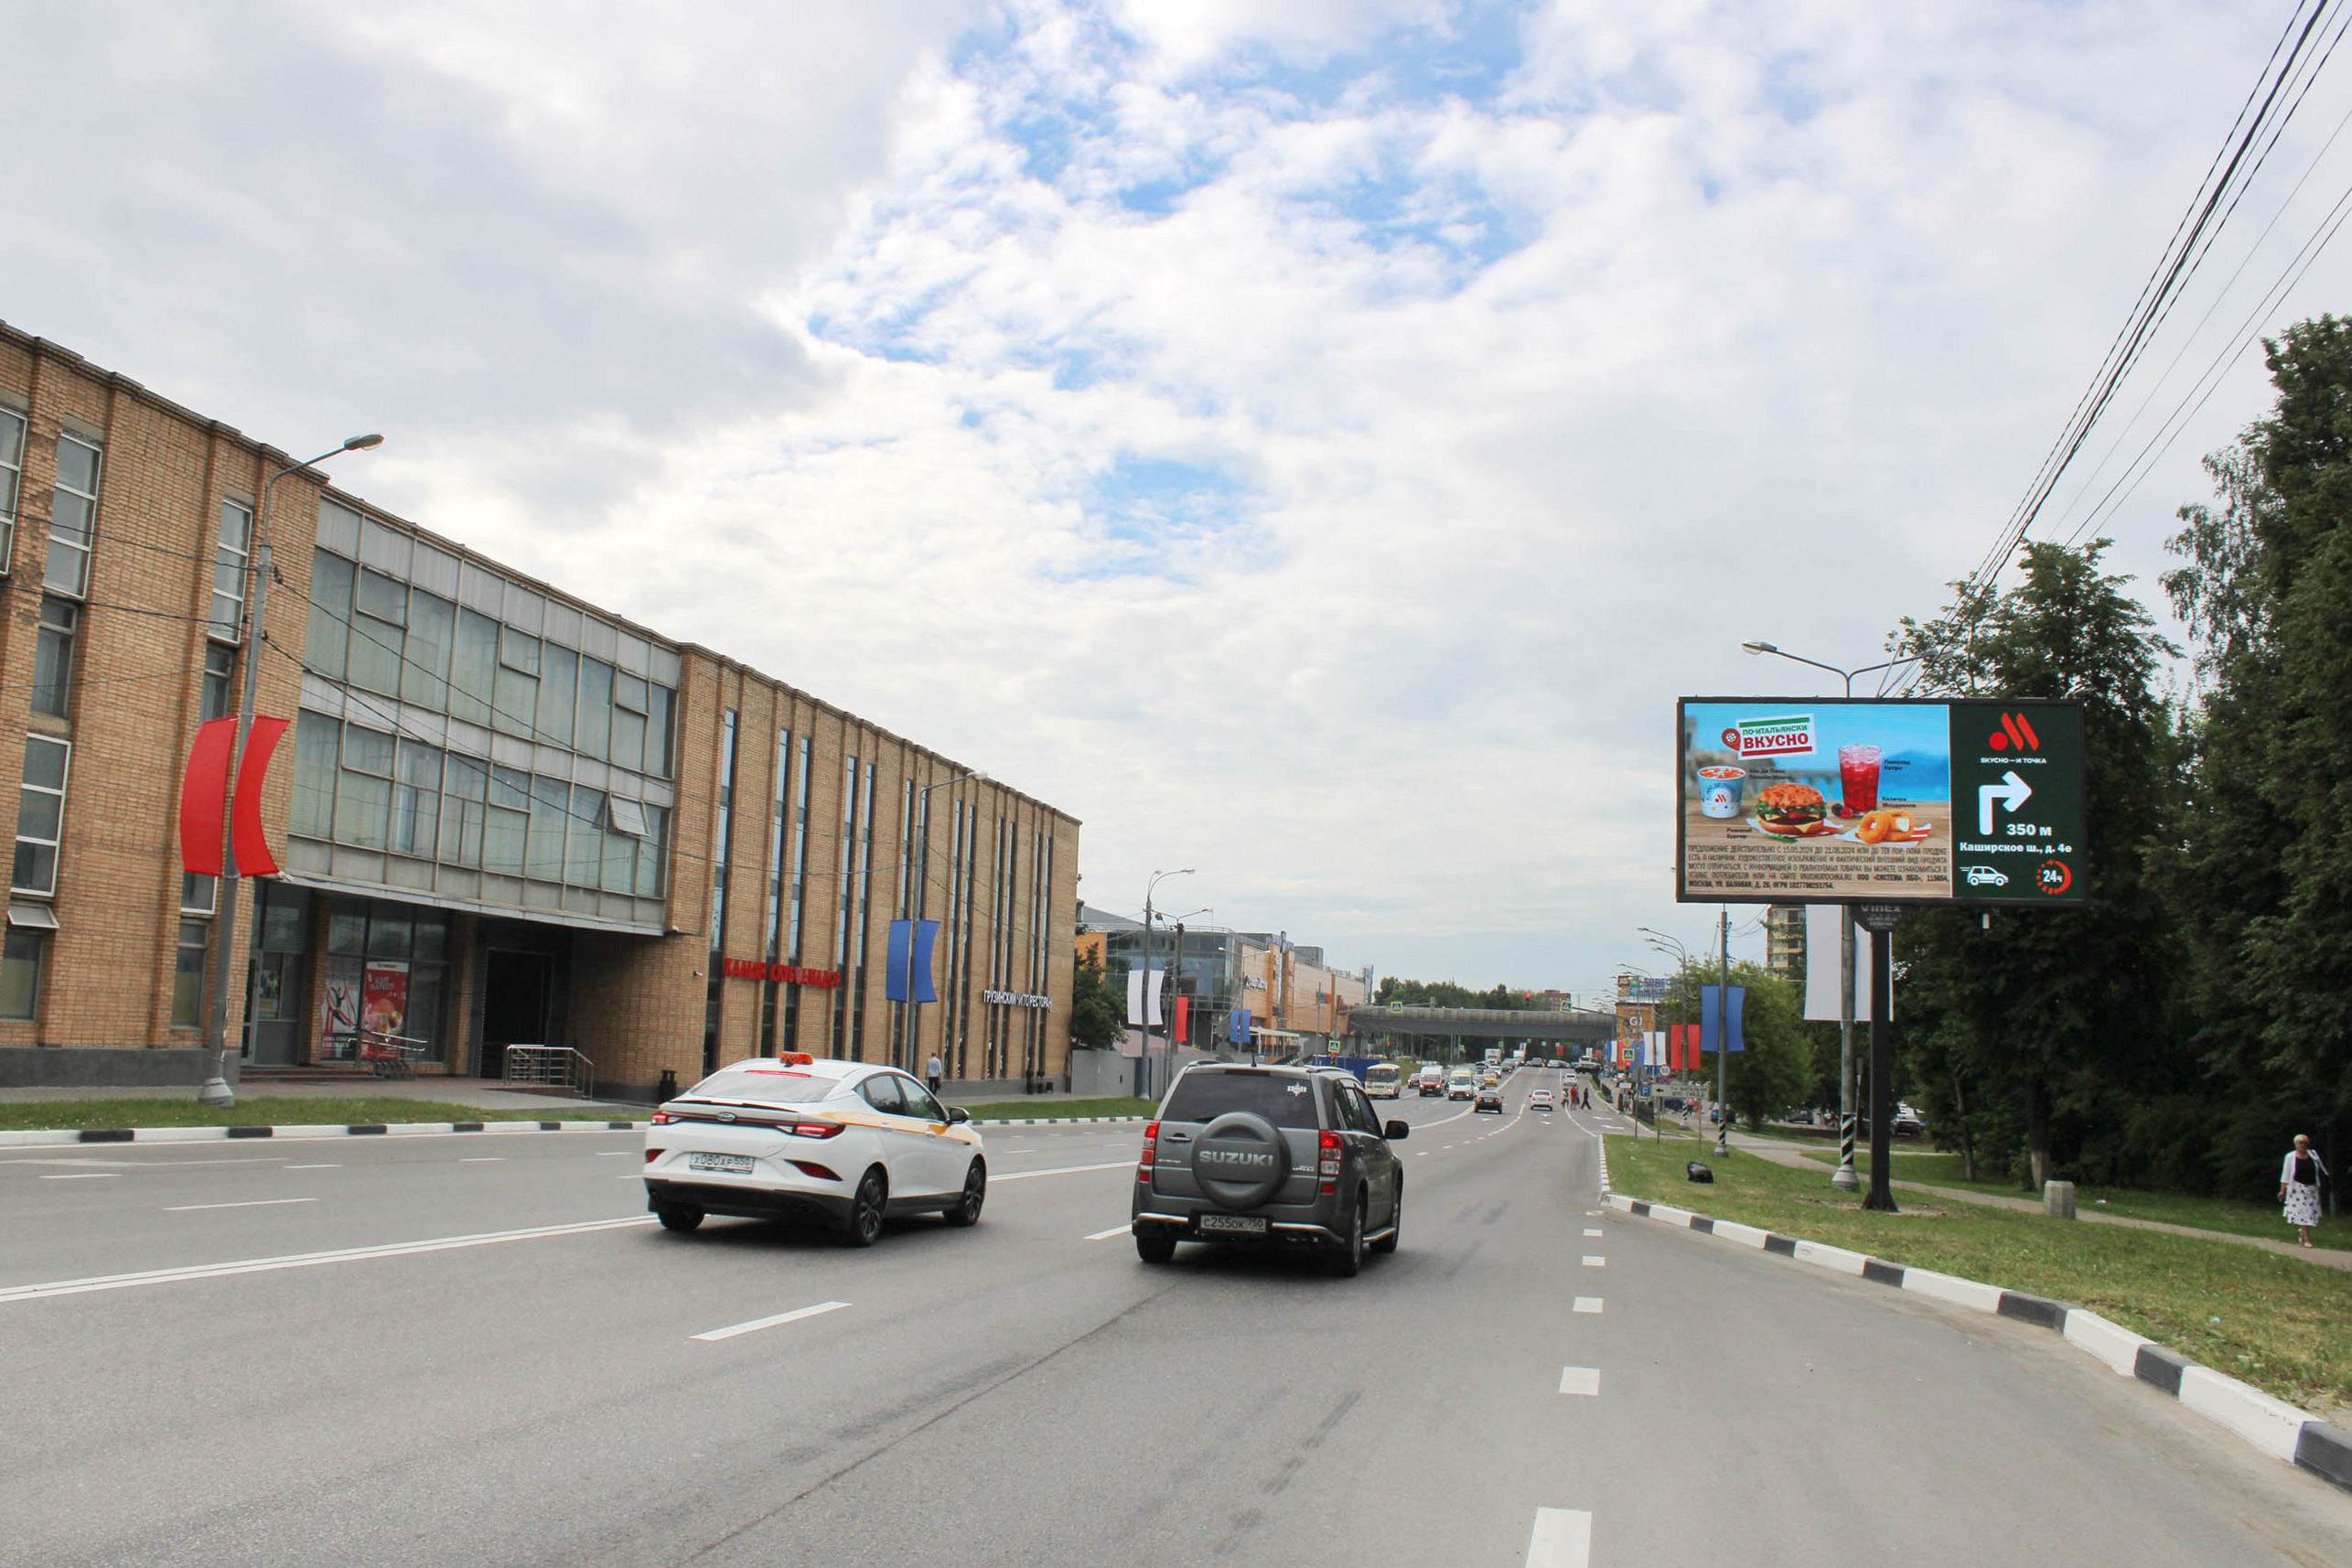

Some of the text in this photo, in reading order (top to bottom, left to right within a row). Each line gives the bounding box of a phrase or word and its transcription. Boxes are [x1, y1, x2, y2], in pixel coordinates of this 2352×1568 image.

[1742, 724, 1808, 736] ПО-ИТАЛЬЯНСКИ
[1743, 732, 1809, 749] ВКУСНО
[2006, 823, 2052, 836] 350 м
[1960, 842, 2024, 854] Каширское
[2057, 843, 2073, 853] 4е
[983, 990, 1016, 1005] ГРУЗИНСКИЙ
[1198, 1150, 1274, 1167] SUZUKI
